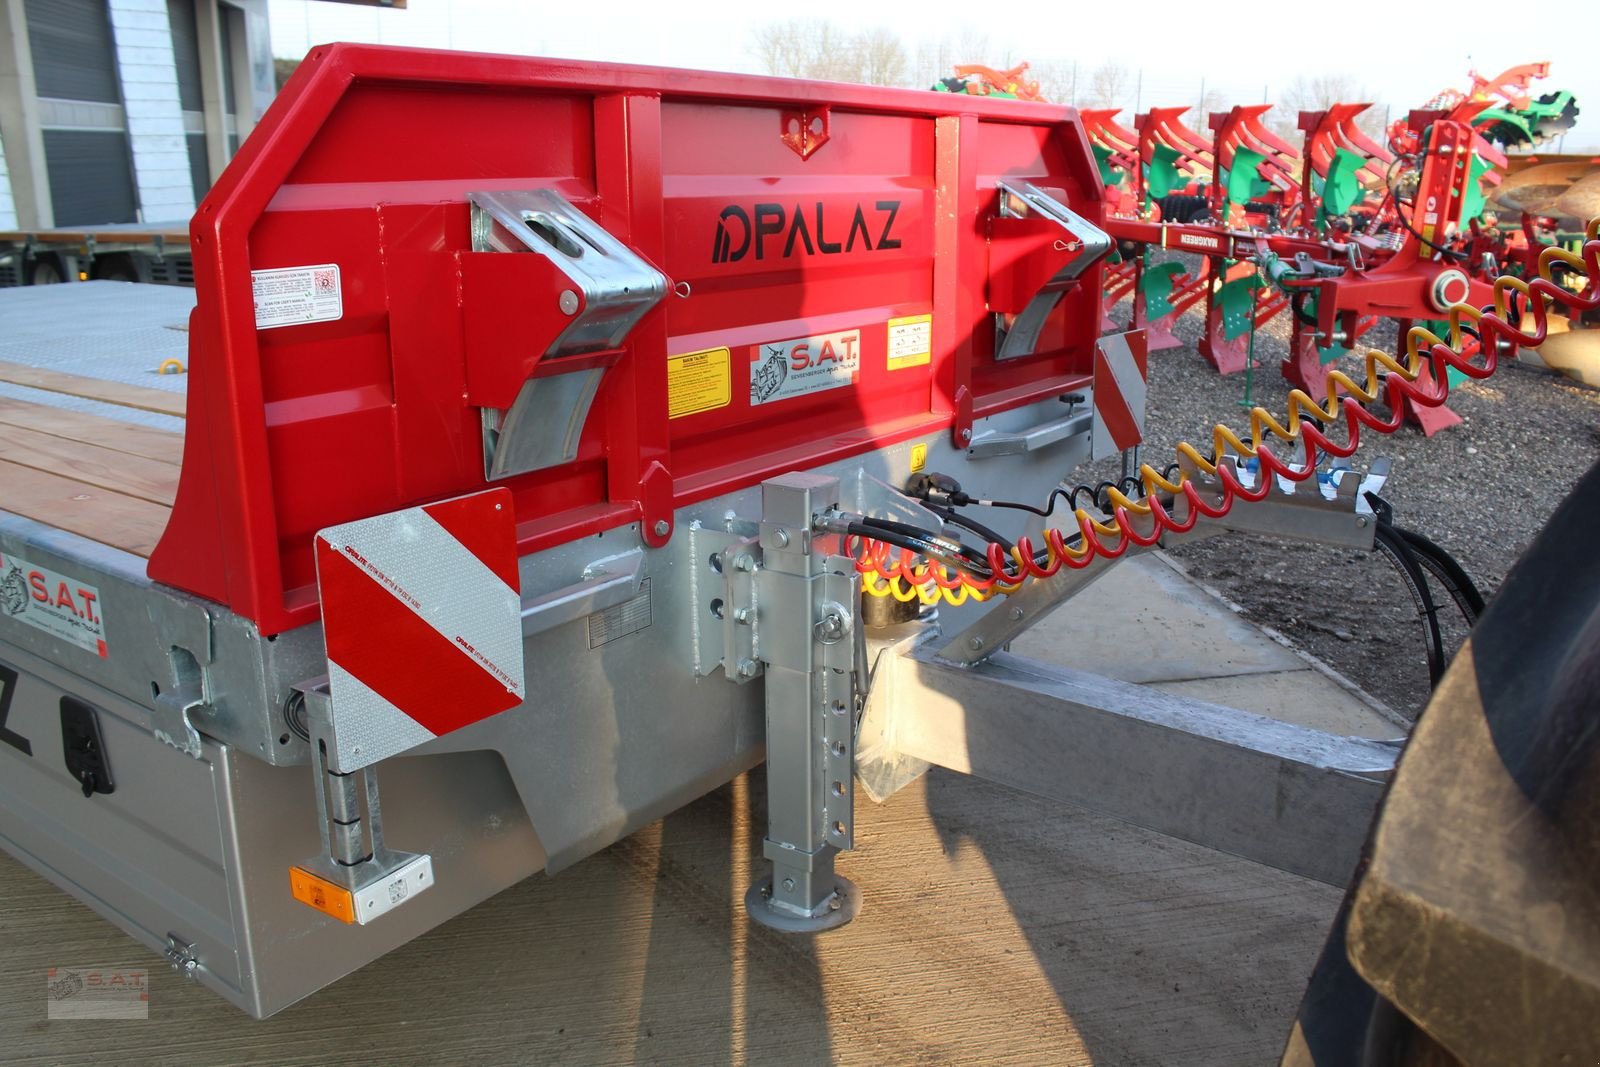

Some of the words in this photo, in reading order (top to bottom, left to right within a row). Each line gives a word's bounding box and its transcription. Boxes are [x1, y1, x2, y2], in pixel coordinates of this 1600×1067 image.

[1181, 234, 1218, 248] MAXGREEN
[791, 335, 857, 371] S.A.T.
[28, 570, 100, 625] S.A.T.
